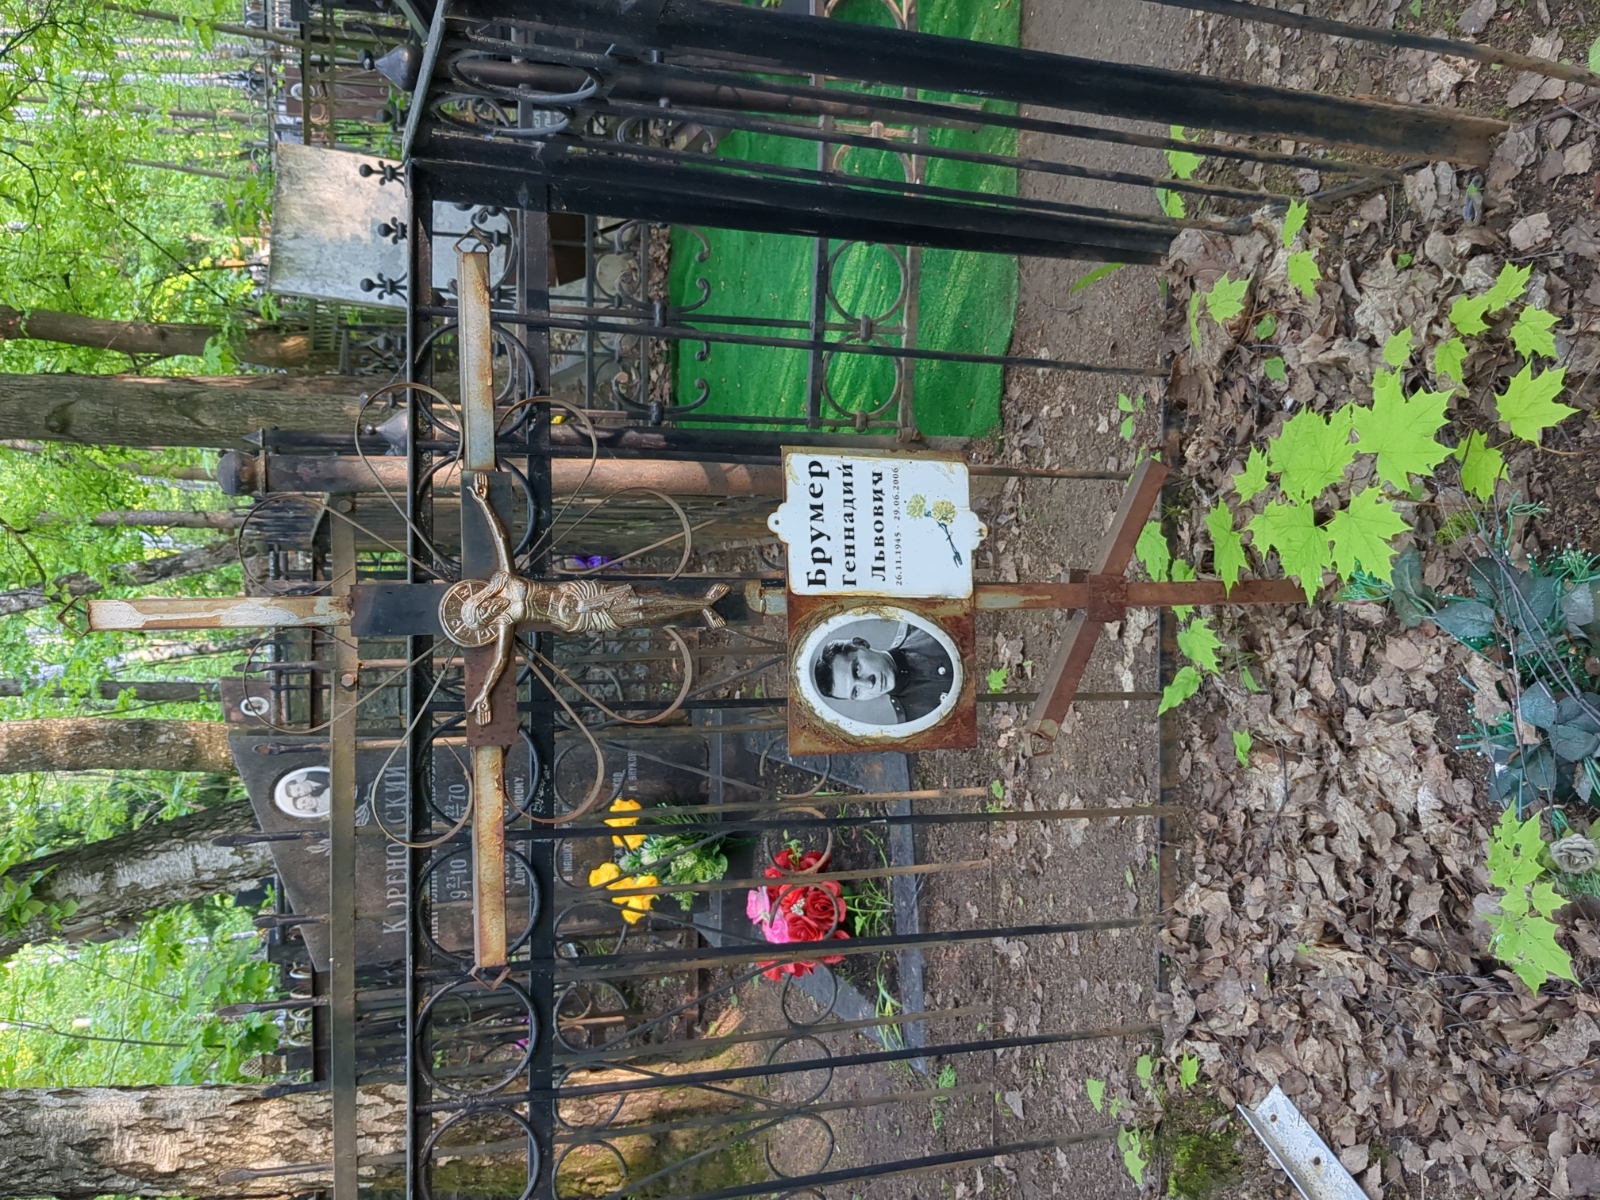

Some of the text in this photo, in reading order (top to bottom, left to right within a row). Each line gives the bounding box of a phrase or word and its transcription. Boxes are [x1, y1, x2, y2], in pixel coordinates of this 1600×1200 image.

[806, 460, 832, 587] Брумер
[836, 463, 857, 587] Геннадий
[871, 471, 885, 582] Львович
[892, 467, 901, 522] 29.06.2006
[895, 532, 903, 586] 26.11.1945
